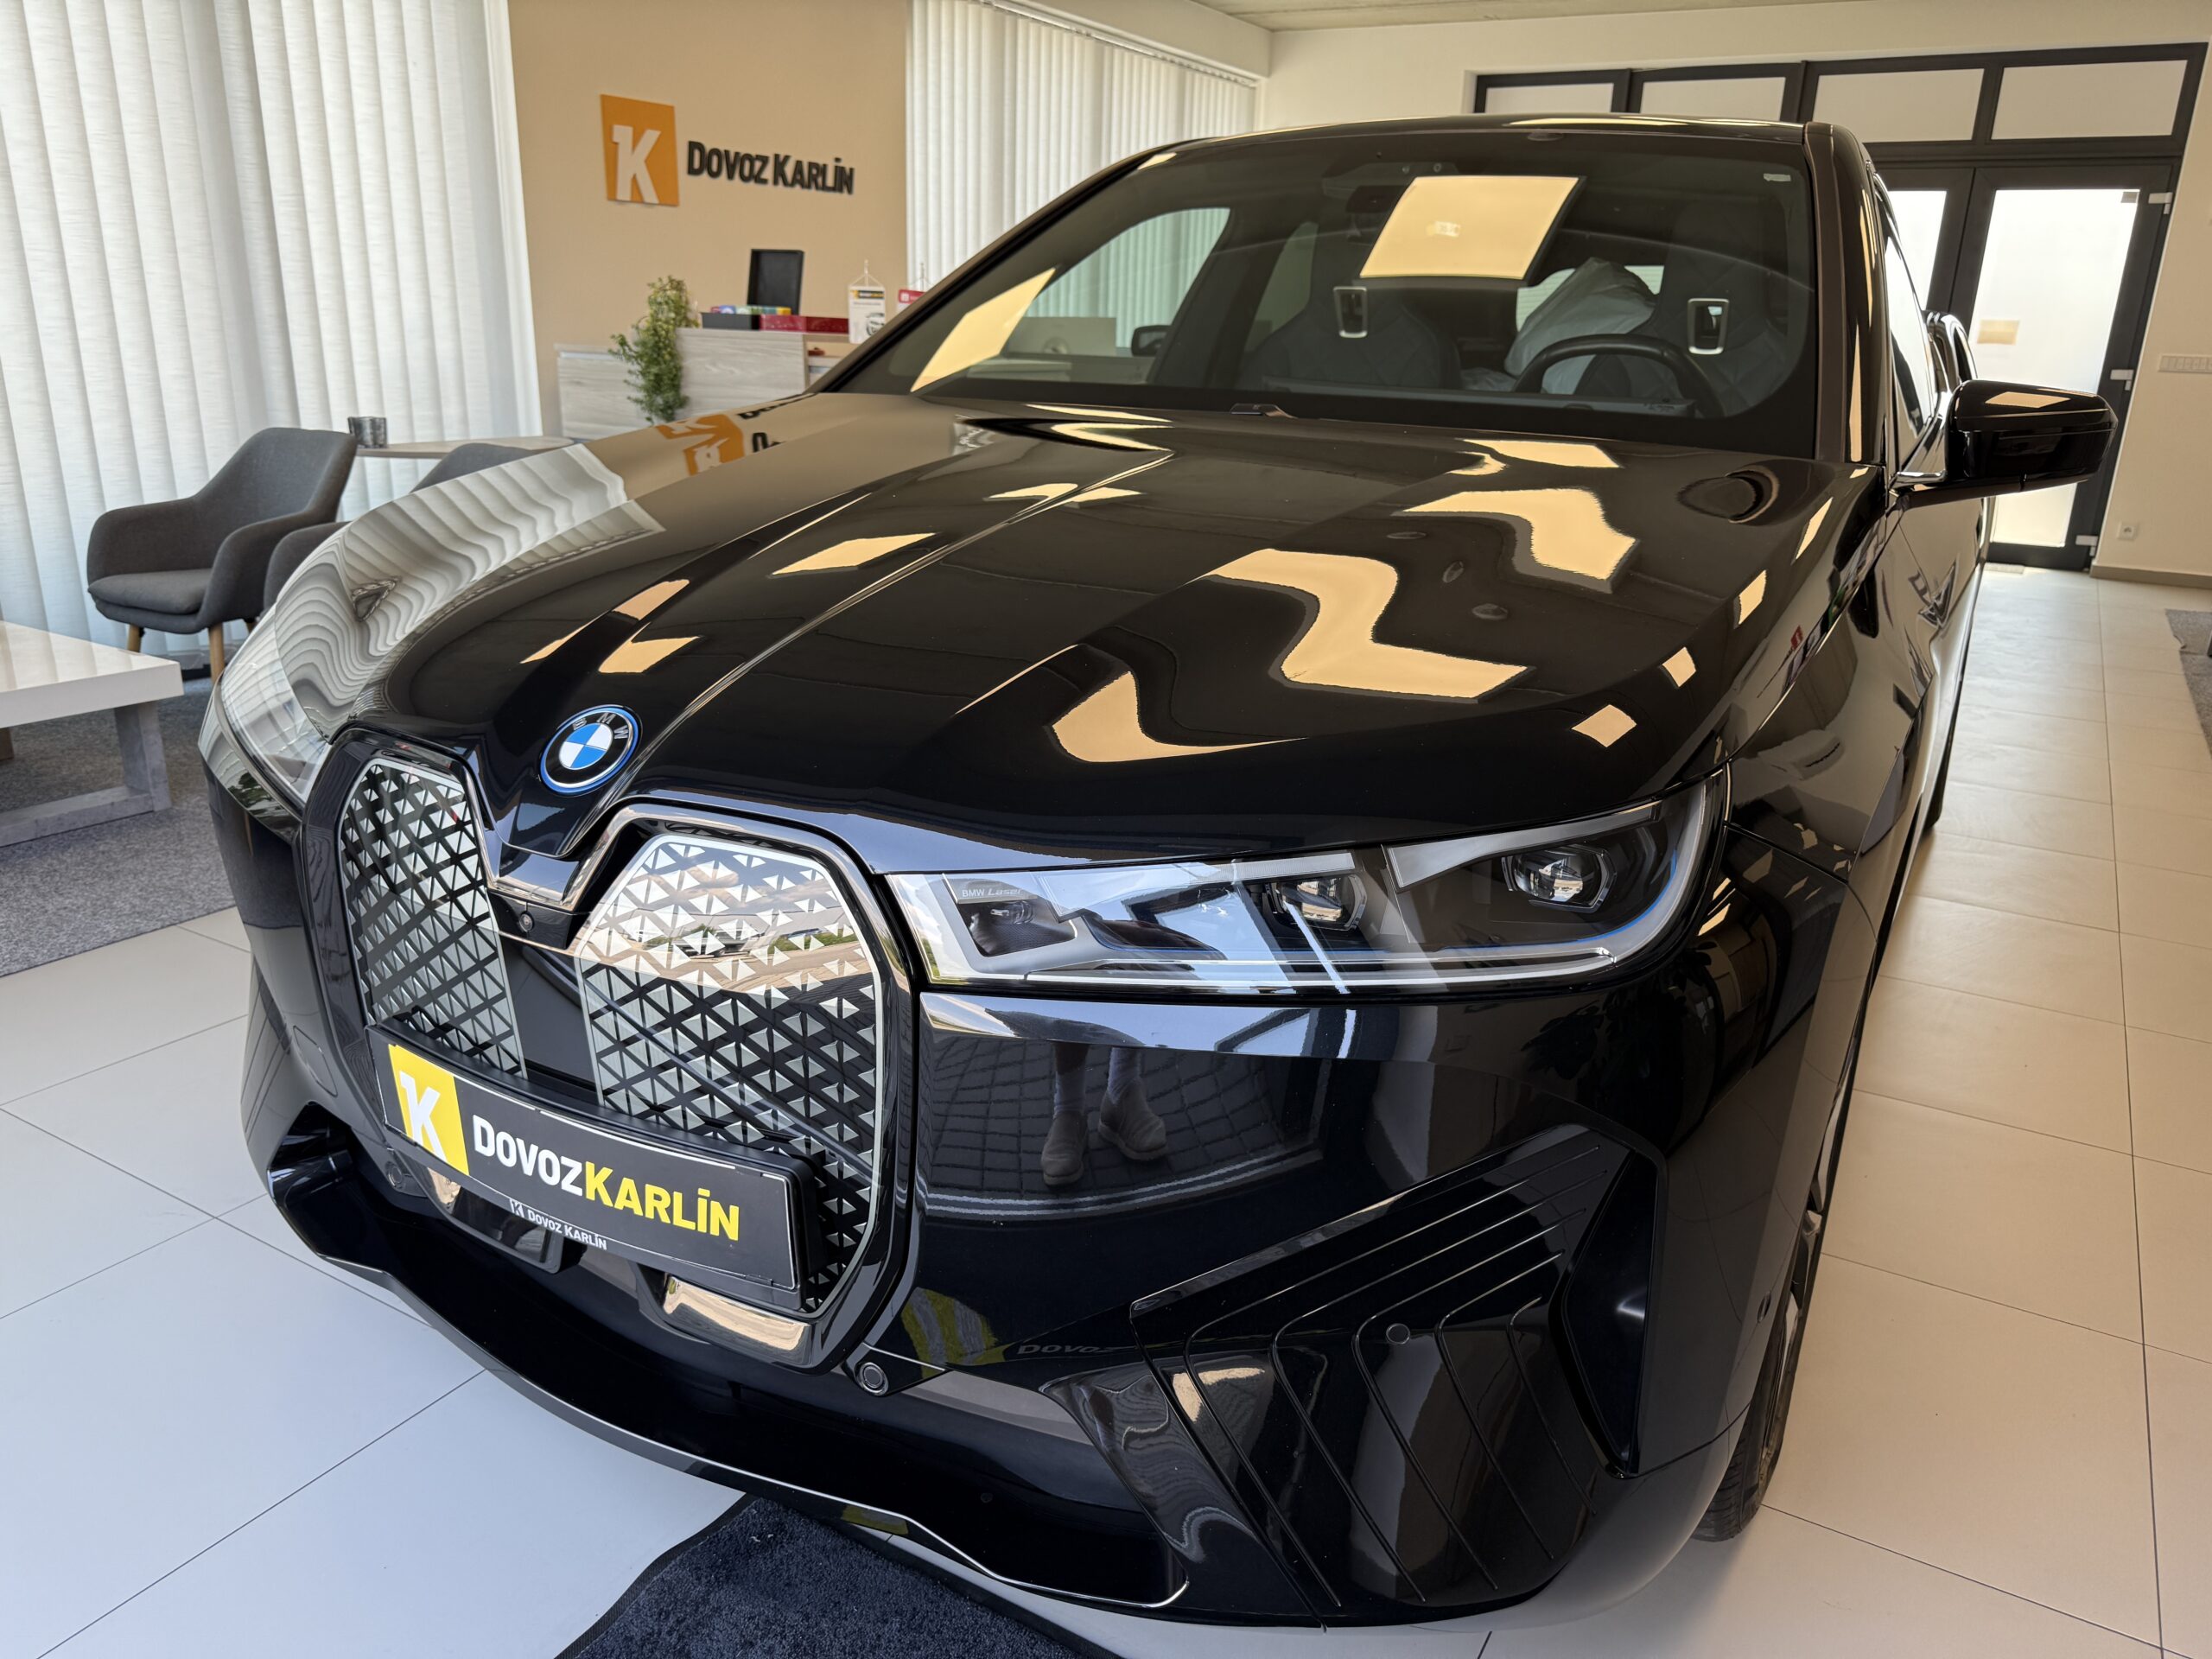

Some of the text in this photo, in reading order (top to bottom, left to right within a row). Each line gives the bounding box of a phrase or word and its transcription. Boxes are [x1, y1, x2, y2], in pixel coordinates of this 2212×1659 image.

[687, 141, 769, 184] DOVOZ
[572, 712, 629, 740] BMW
[962, 887, 1021, 898] BMW Laser
[527, 1209, 563, 1234] DOVOZ
